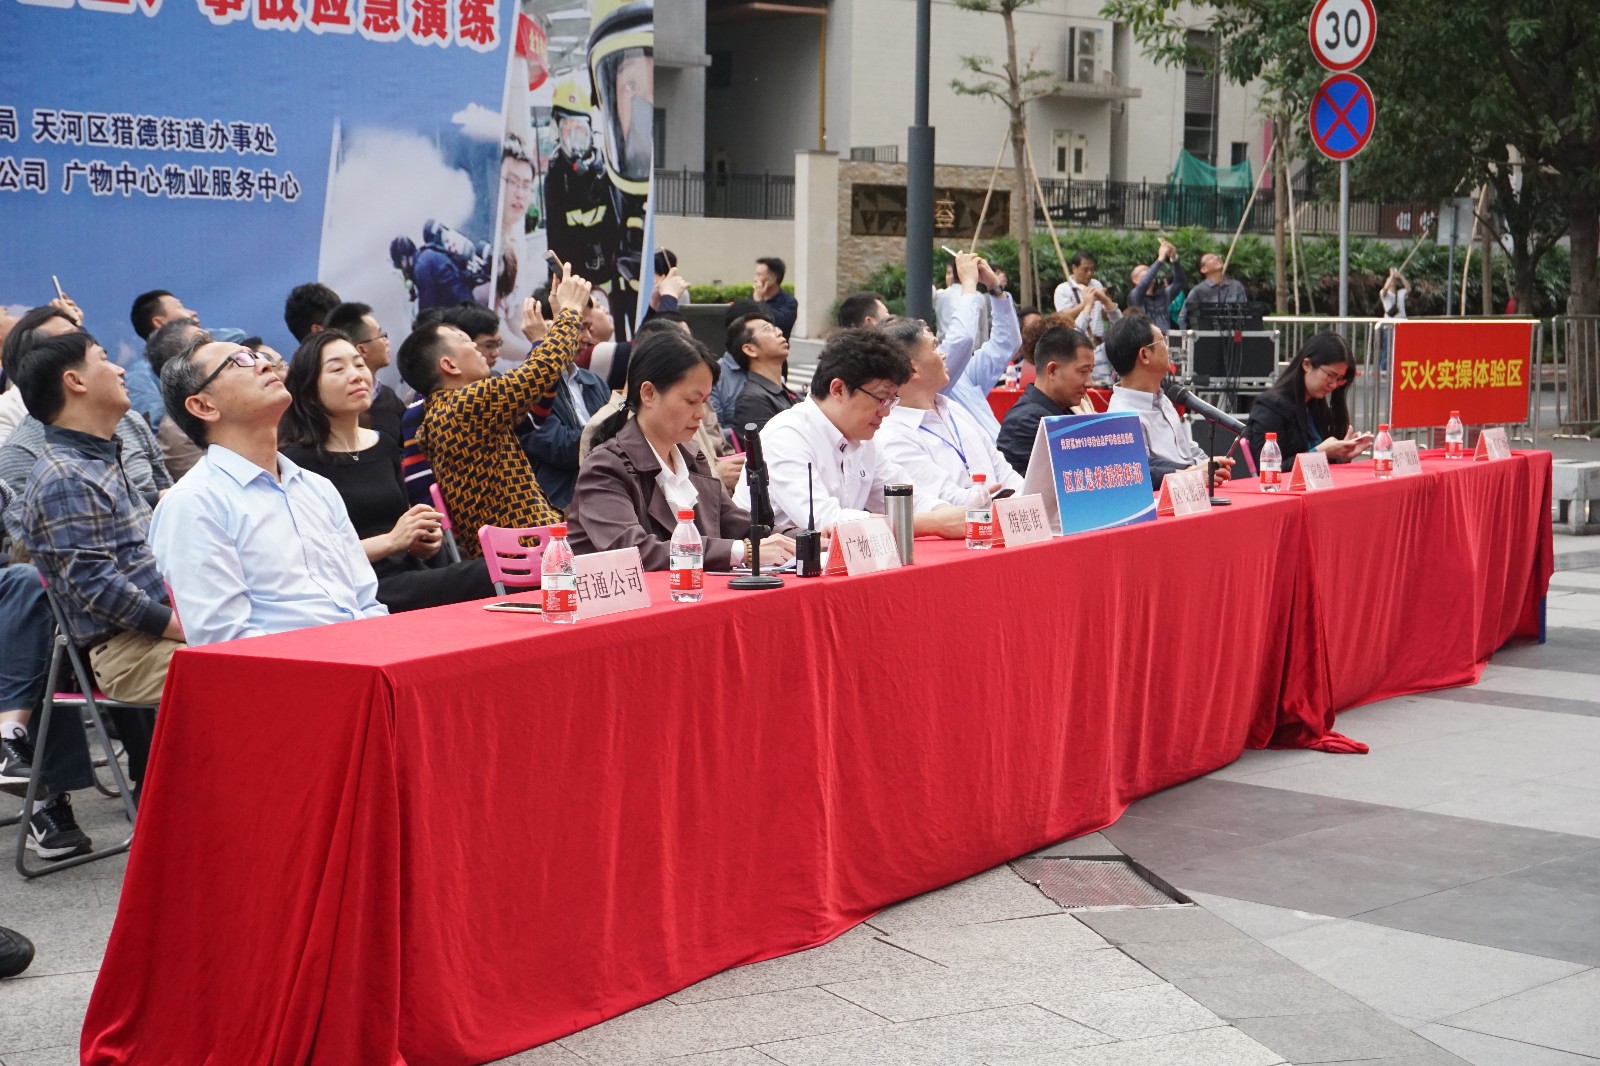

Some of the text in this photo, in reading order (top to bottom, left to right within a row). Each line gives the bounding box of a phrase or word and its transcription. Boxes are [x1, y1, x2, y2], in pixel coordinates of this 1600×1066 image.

[1325, 9, 1361, 49] 30
[34, 110, 276, 153] 天河区猎德街道办事处
[0, 159, 300, 200] 公司 广物中心物业服务中心
[1399, 357, 1523, 391] 灭火实操体验区
[1062, 461, 1144, 494] 区应急救援指挥部
[1007, 508, 1043, 534] 猎德街
[845, 532, 895, 562] 广物集团
[576, 566, 643, 603] 百通公司
